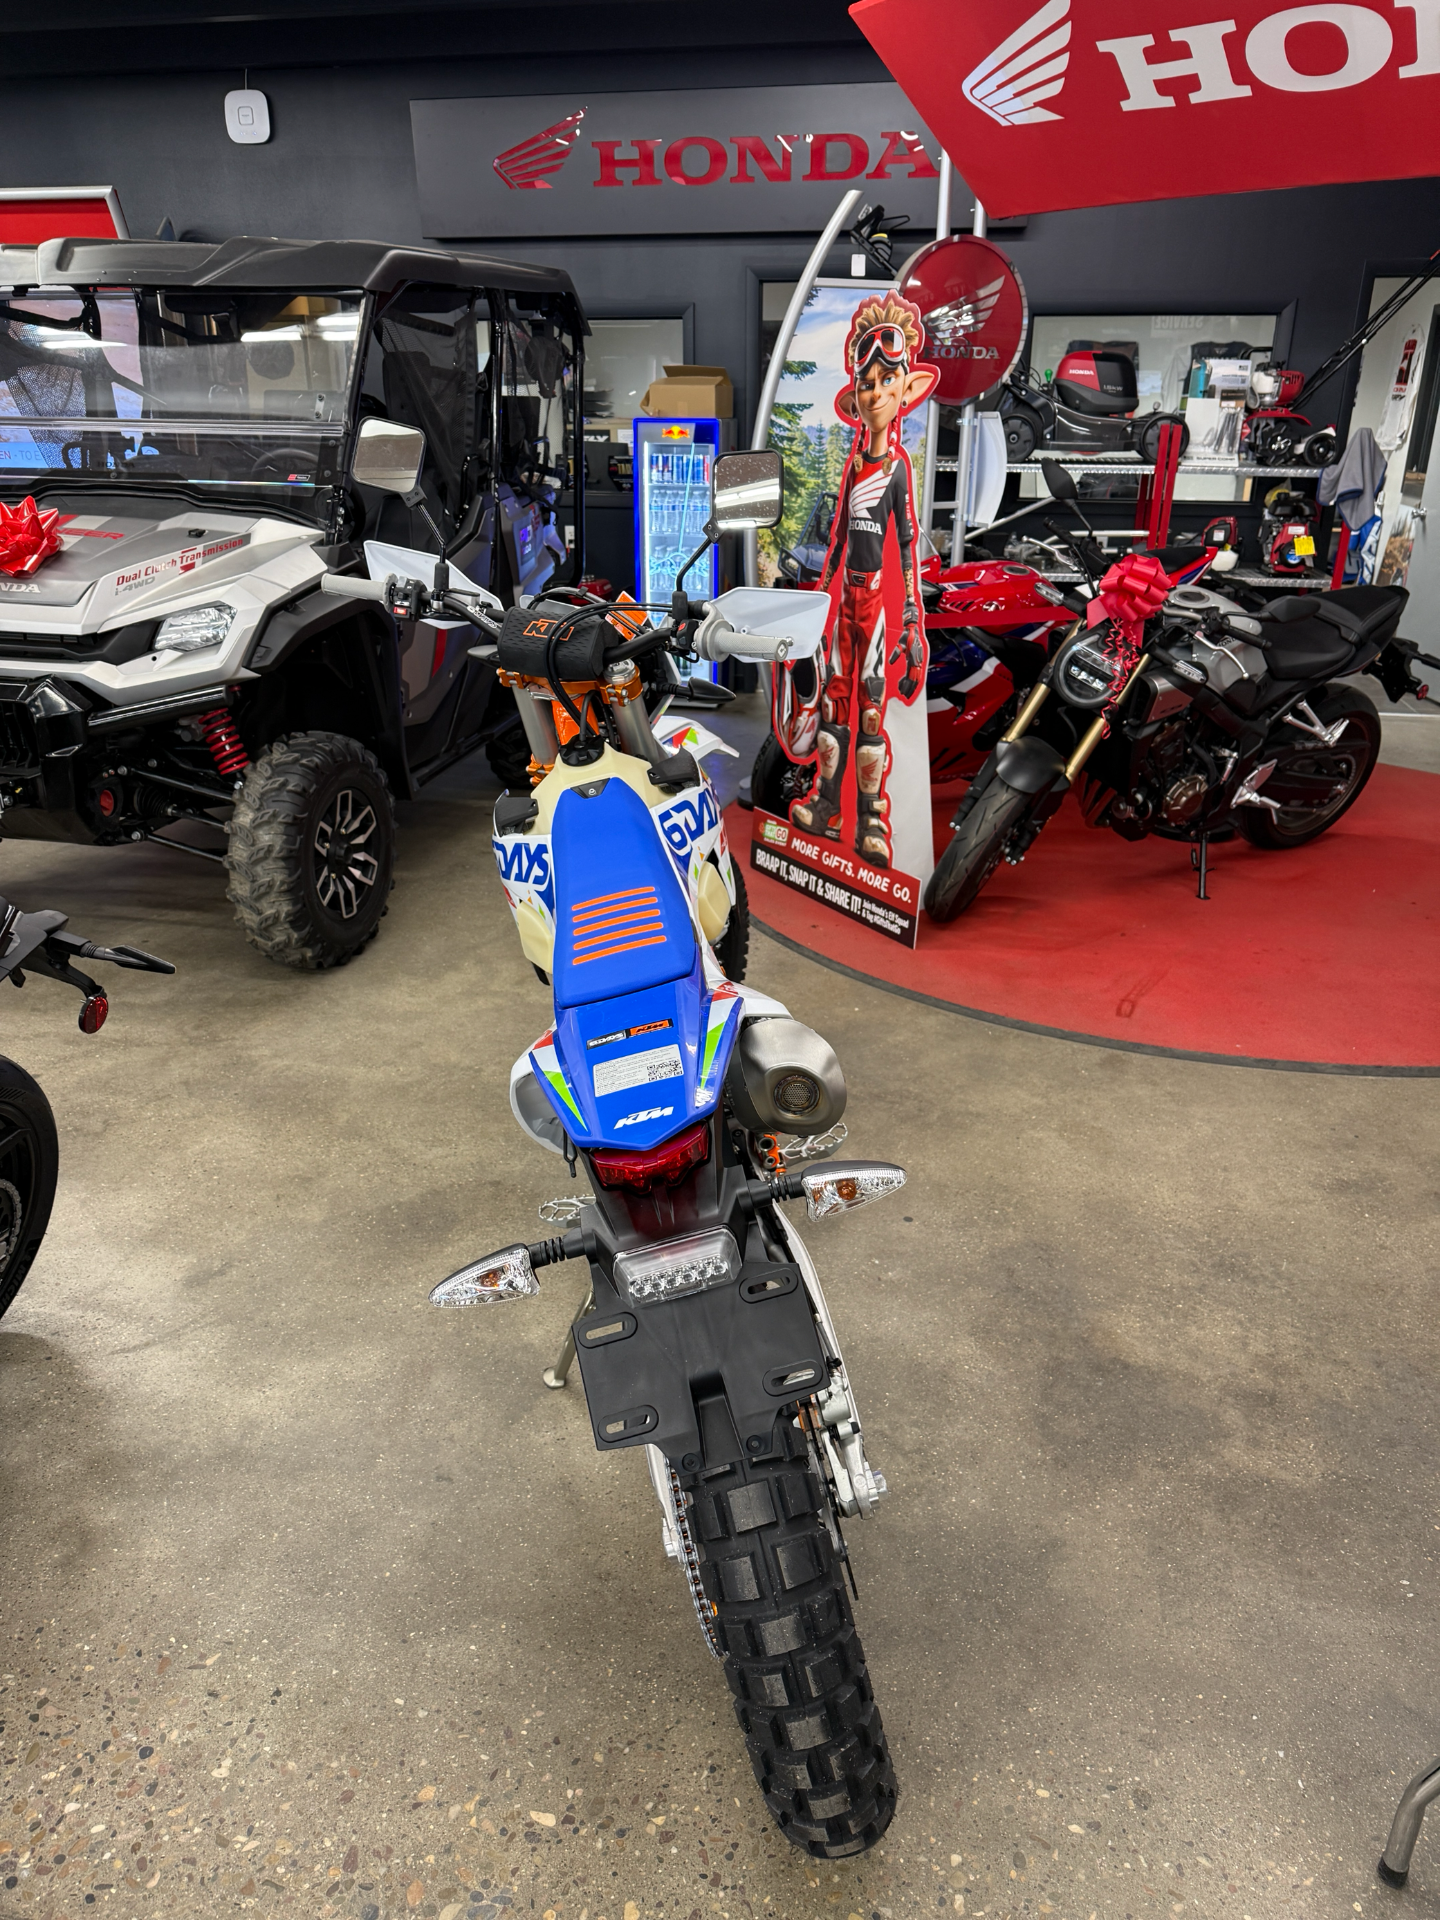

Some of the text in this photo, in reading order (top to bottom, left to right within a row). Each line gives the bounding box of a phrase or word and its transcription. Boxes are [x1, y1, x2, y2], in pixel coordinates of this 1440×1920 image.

[592, 131, 940, 187] HONDA
[922, 346, 1000, 359] HONDA
[57, 528, 125, 540] NEER
[849, 519, 882, 535] HONDA
[116, 539, 243, 586] Dual Clutch Transmission
[115, 576, 155, 596] i-4WD
[776, 828, 787, 840] GO
[492, 840, 549, 885] DAYS
[791, 838, 912, 904] MORE GIFTS. MORE GO.
[756, 848, 862, 914] BRAAP IT, SNAP IT & SHARE IT!
[613, 1106, 674, 1130] KTM
